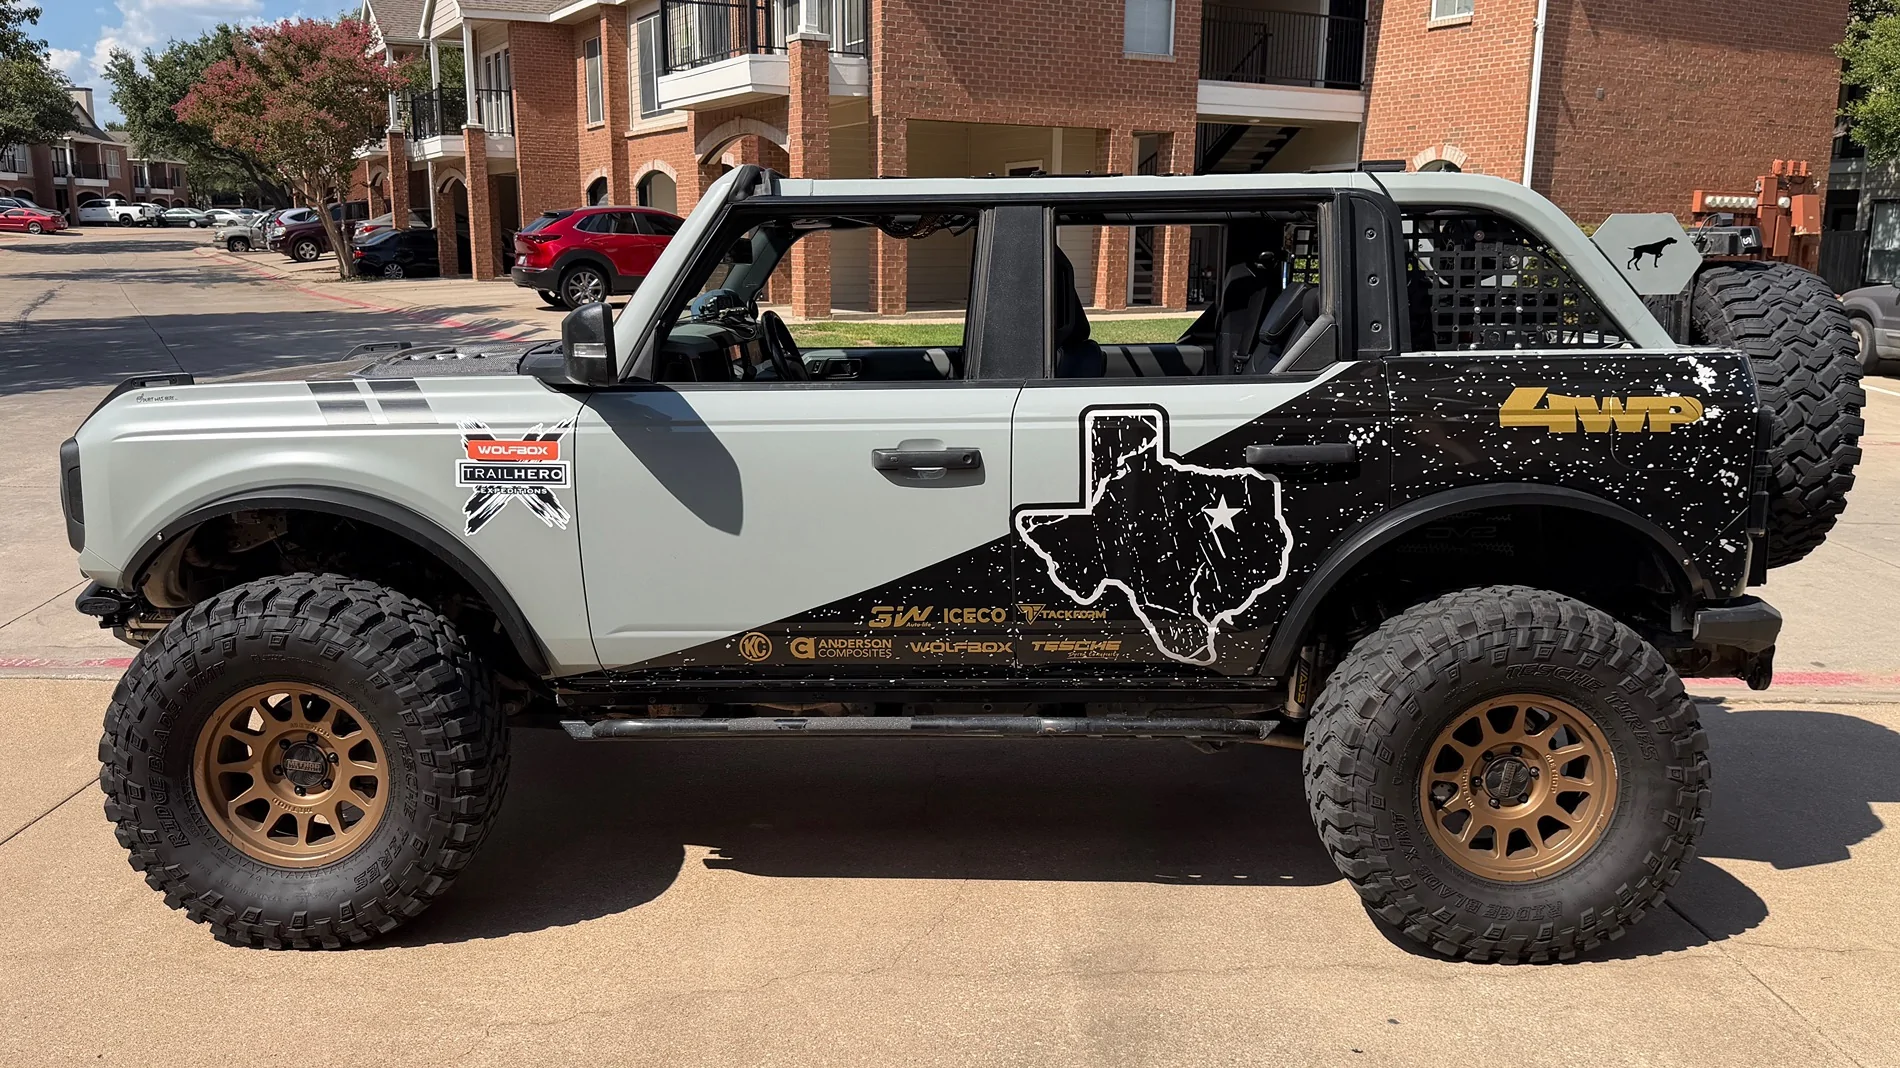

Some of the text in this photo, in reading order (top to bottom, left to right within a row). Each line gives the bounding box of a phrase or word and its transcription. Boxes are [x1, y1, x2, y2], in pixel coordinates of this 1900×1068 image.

[477, 445, 549, 455] WOLFBOX
[464, 468, 563, 479] TRAILHERO
[943, 607, 1007, 624] ICECO
[1041, 610, 1107, 619] TACKFORM
[818, 638, 892, 648] ANDERSON
[910, 642, 1013, 653] WOLFBOX
[1031, 640, 1122, 651] TESCHE
[818, 648, 892, 658] COMPOSITES
[1506, 662, 1605, 692] TESCHE
[1604, 691, 1659, 761] TIRES
[148, 699, 181, 773] BLADE
[149, 776, 190, 848] RIDGE
[1414, 864, 1482, 913] BLADE
[1484, 901, 1563, 922] RIDGE
